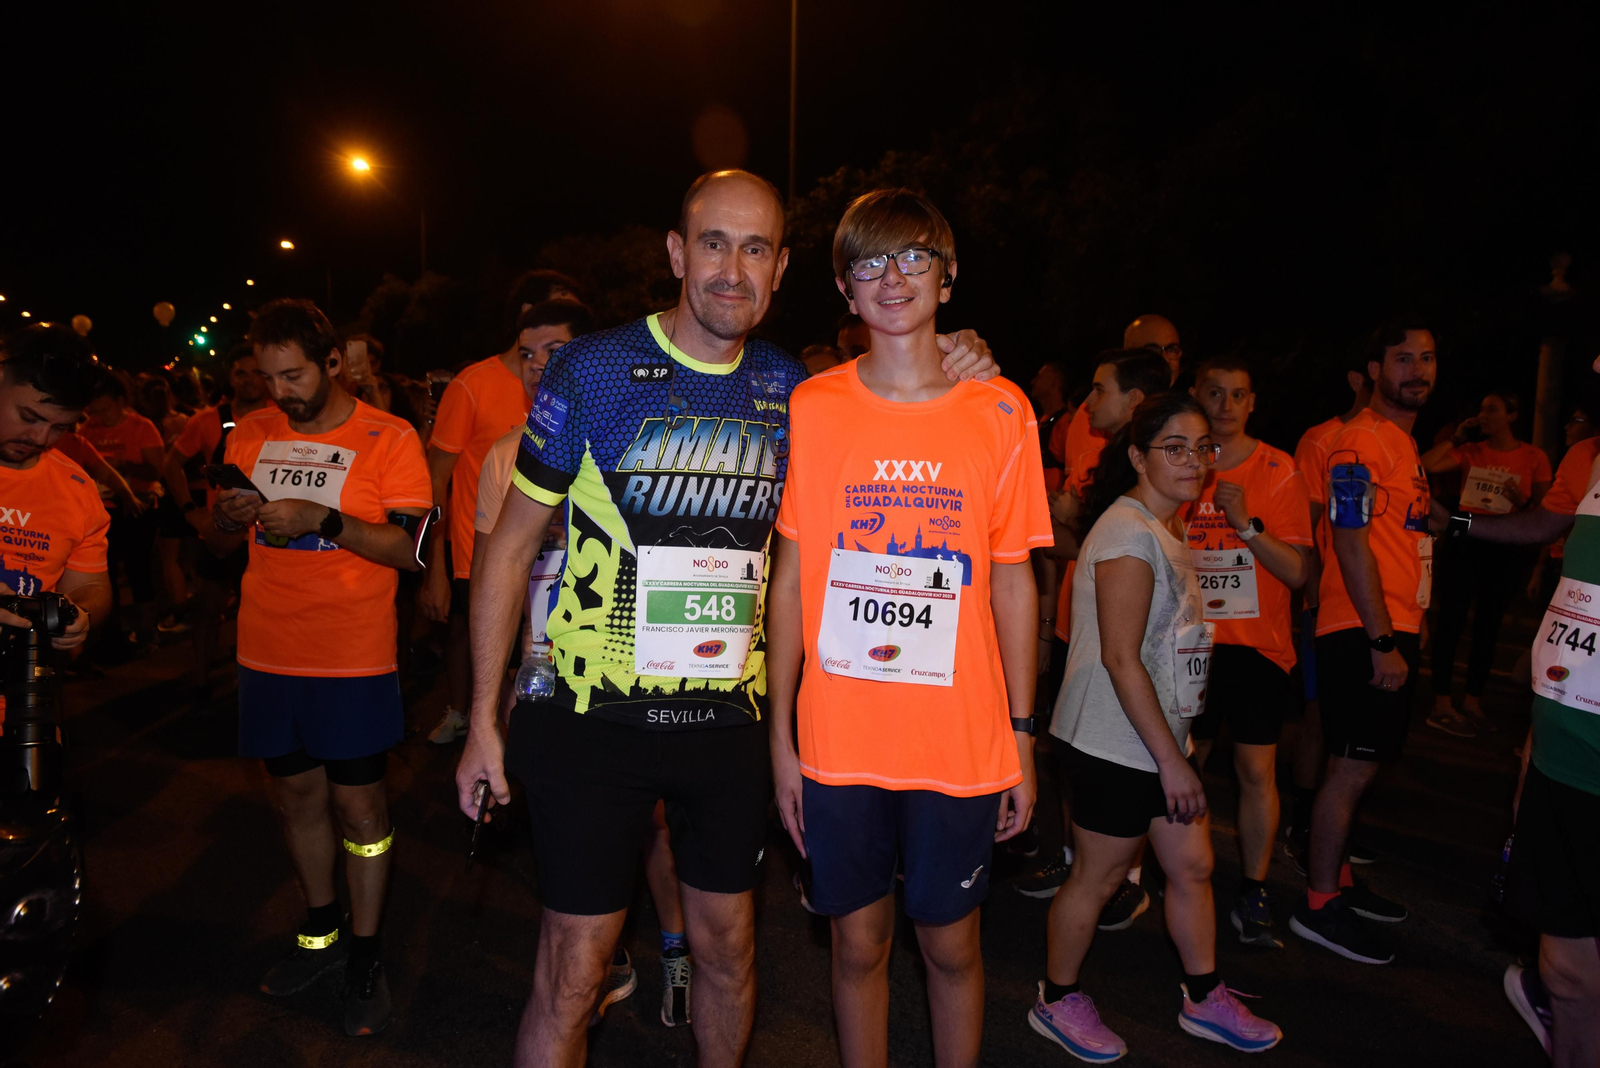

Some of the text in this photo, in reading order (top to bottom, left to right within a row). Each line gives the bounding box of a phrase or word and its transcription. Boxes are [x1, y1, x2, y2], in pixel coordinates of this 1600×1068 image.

[269, 468, 327, 488] 17618
[872, 460, 942, 482] XXXV
[845, 484, 964, 498] CARRERA NOCTURNA
[852, 496, 962, 512] GUADALQUIVIR
[898, 590, 932, 598] GUADALQUIVIR
[684, 594, 736, 621] 548
[848, 596, 933, 629] 10694
[1546, 620, 1597, 656] 2744
[910, 668, 946, 678] Cruzcampo
[646, 708, 715, 724] SEVILLA
